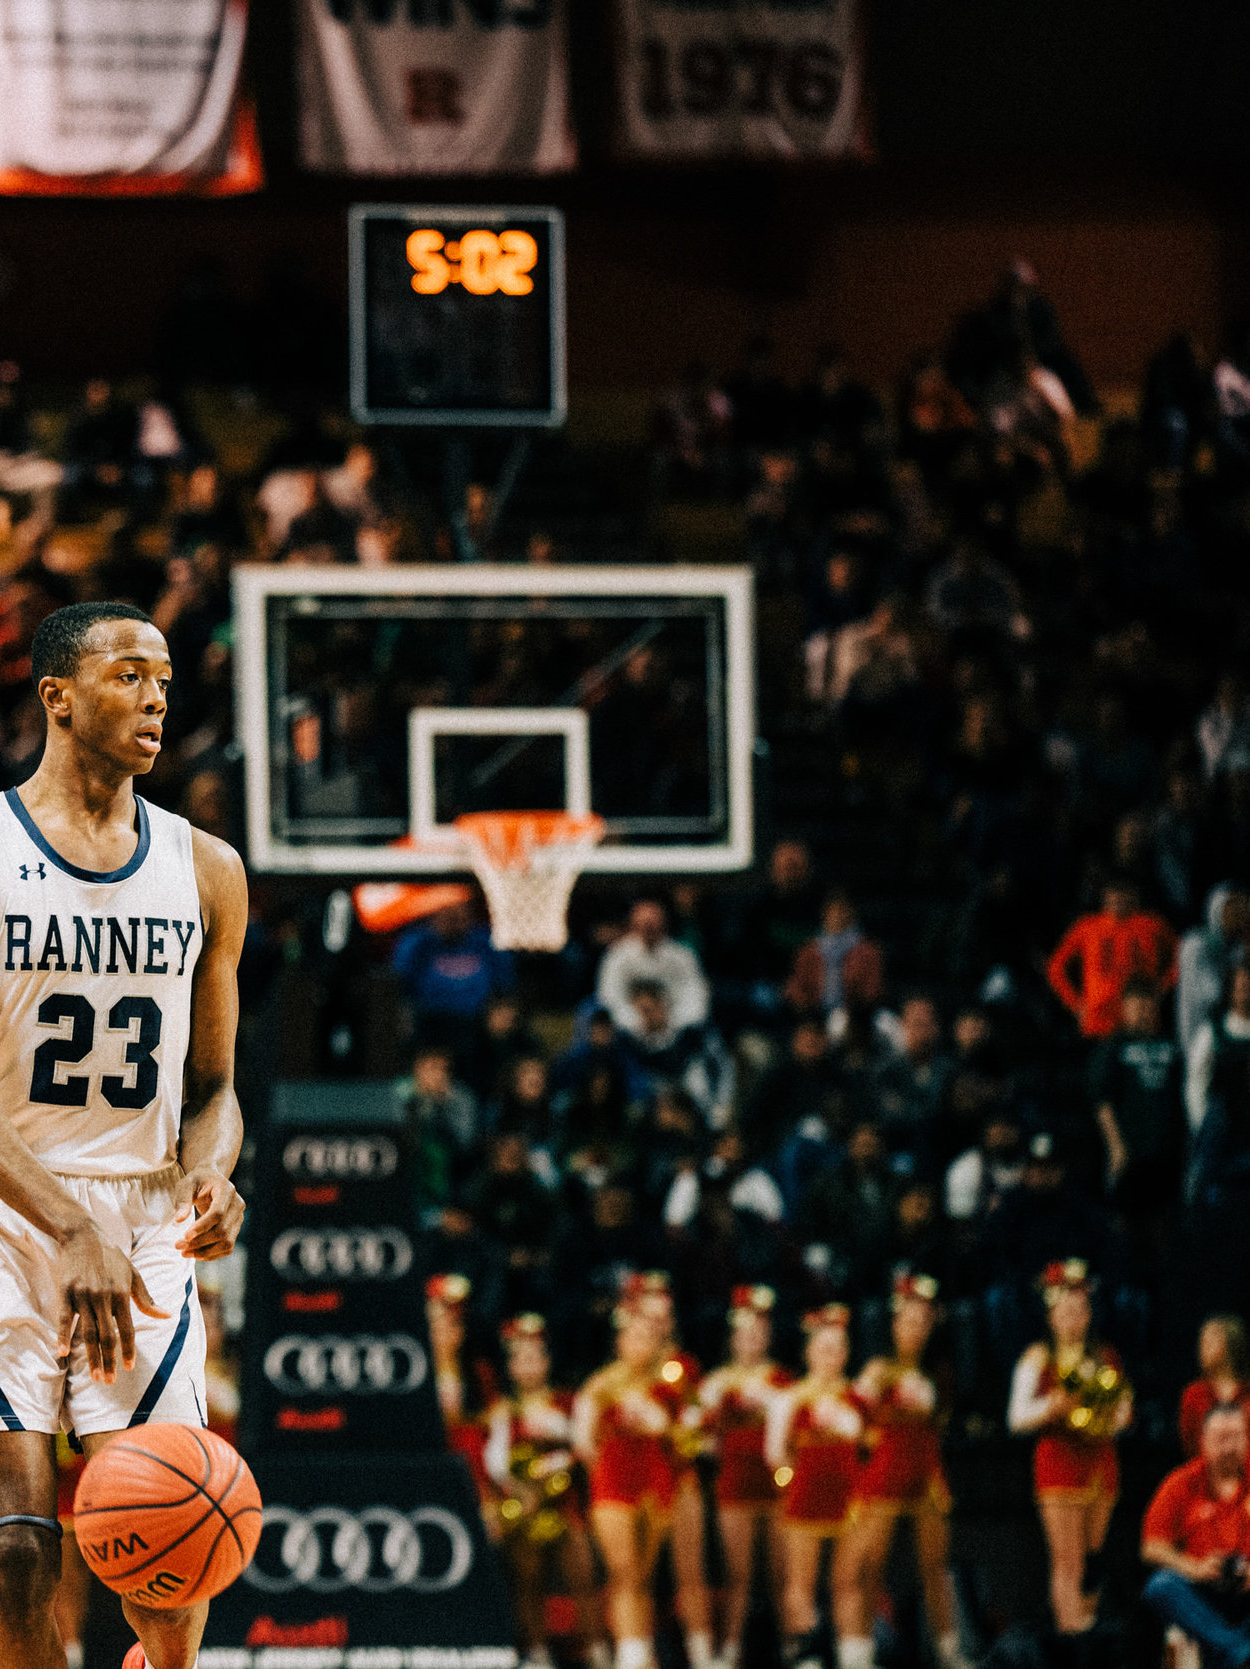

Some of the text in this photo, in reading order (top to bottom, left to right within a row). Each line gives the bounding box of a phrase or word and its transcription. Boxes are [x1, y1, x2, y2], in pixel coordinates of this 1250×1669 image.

[641, 36, 844, 121] 1976
[406, 229, 538, 295] 5:02
[4, 914, 196, 977] RANNEY
[29, 993, 163, 1110] 23
